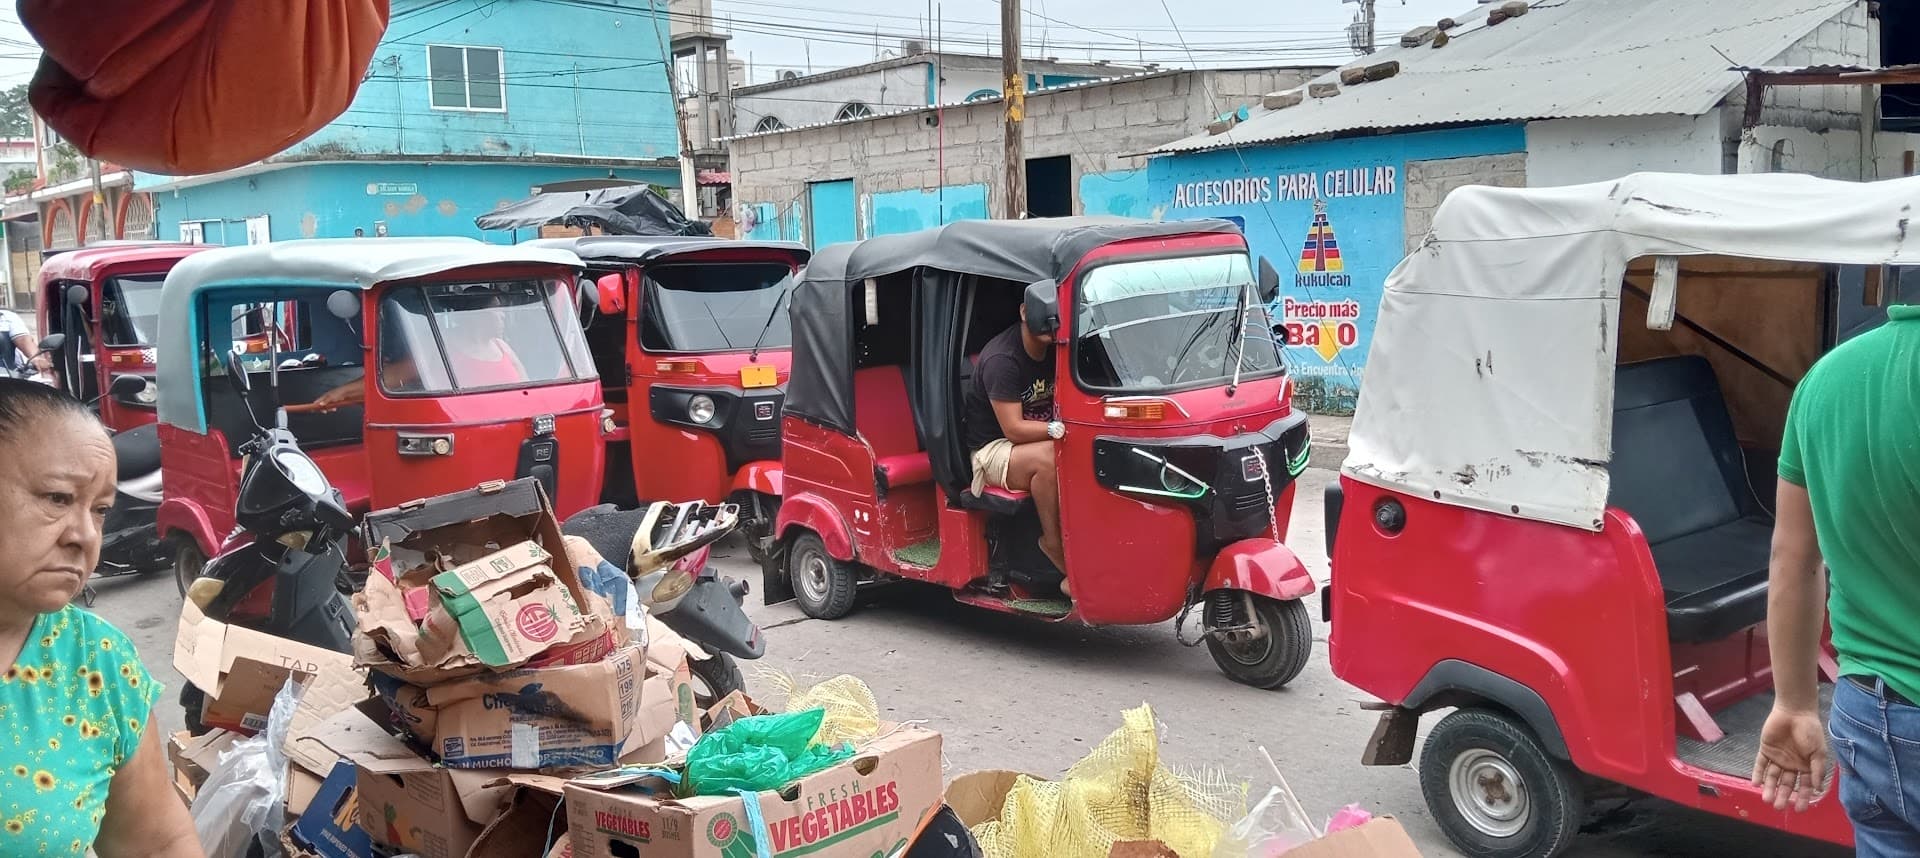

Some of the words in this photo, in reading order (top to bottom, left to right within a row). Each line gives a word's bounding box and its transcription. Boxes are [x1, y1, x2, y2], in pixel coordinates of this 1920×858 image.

[1173, 176, 1271, 208] ACCESORIOS
[1277, 171, 1320, 201] PARA
[1324, 165, 1397, 198] CELULAR
[1284, 298, 1326, 318] Precio
[1329, 300, 1358, 318] más
[536, 447, 549, 456] RE
[616, 659, 631, 675] 175
[472, 757, 512, 769] MUCHO
[807, 779, 860, 810] FRESH
[594, 810, 651, 838] VEGETABLES
[769, 781, 899, 852] VEGETABLES
